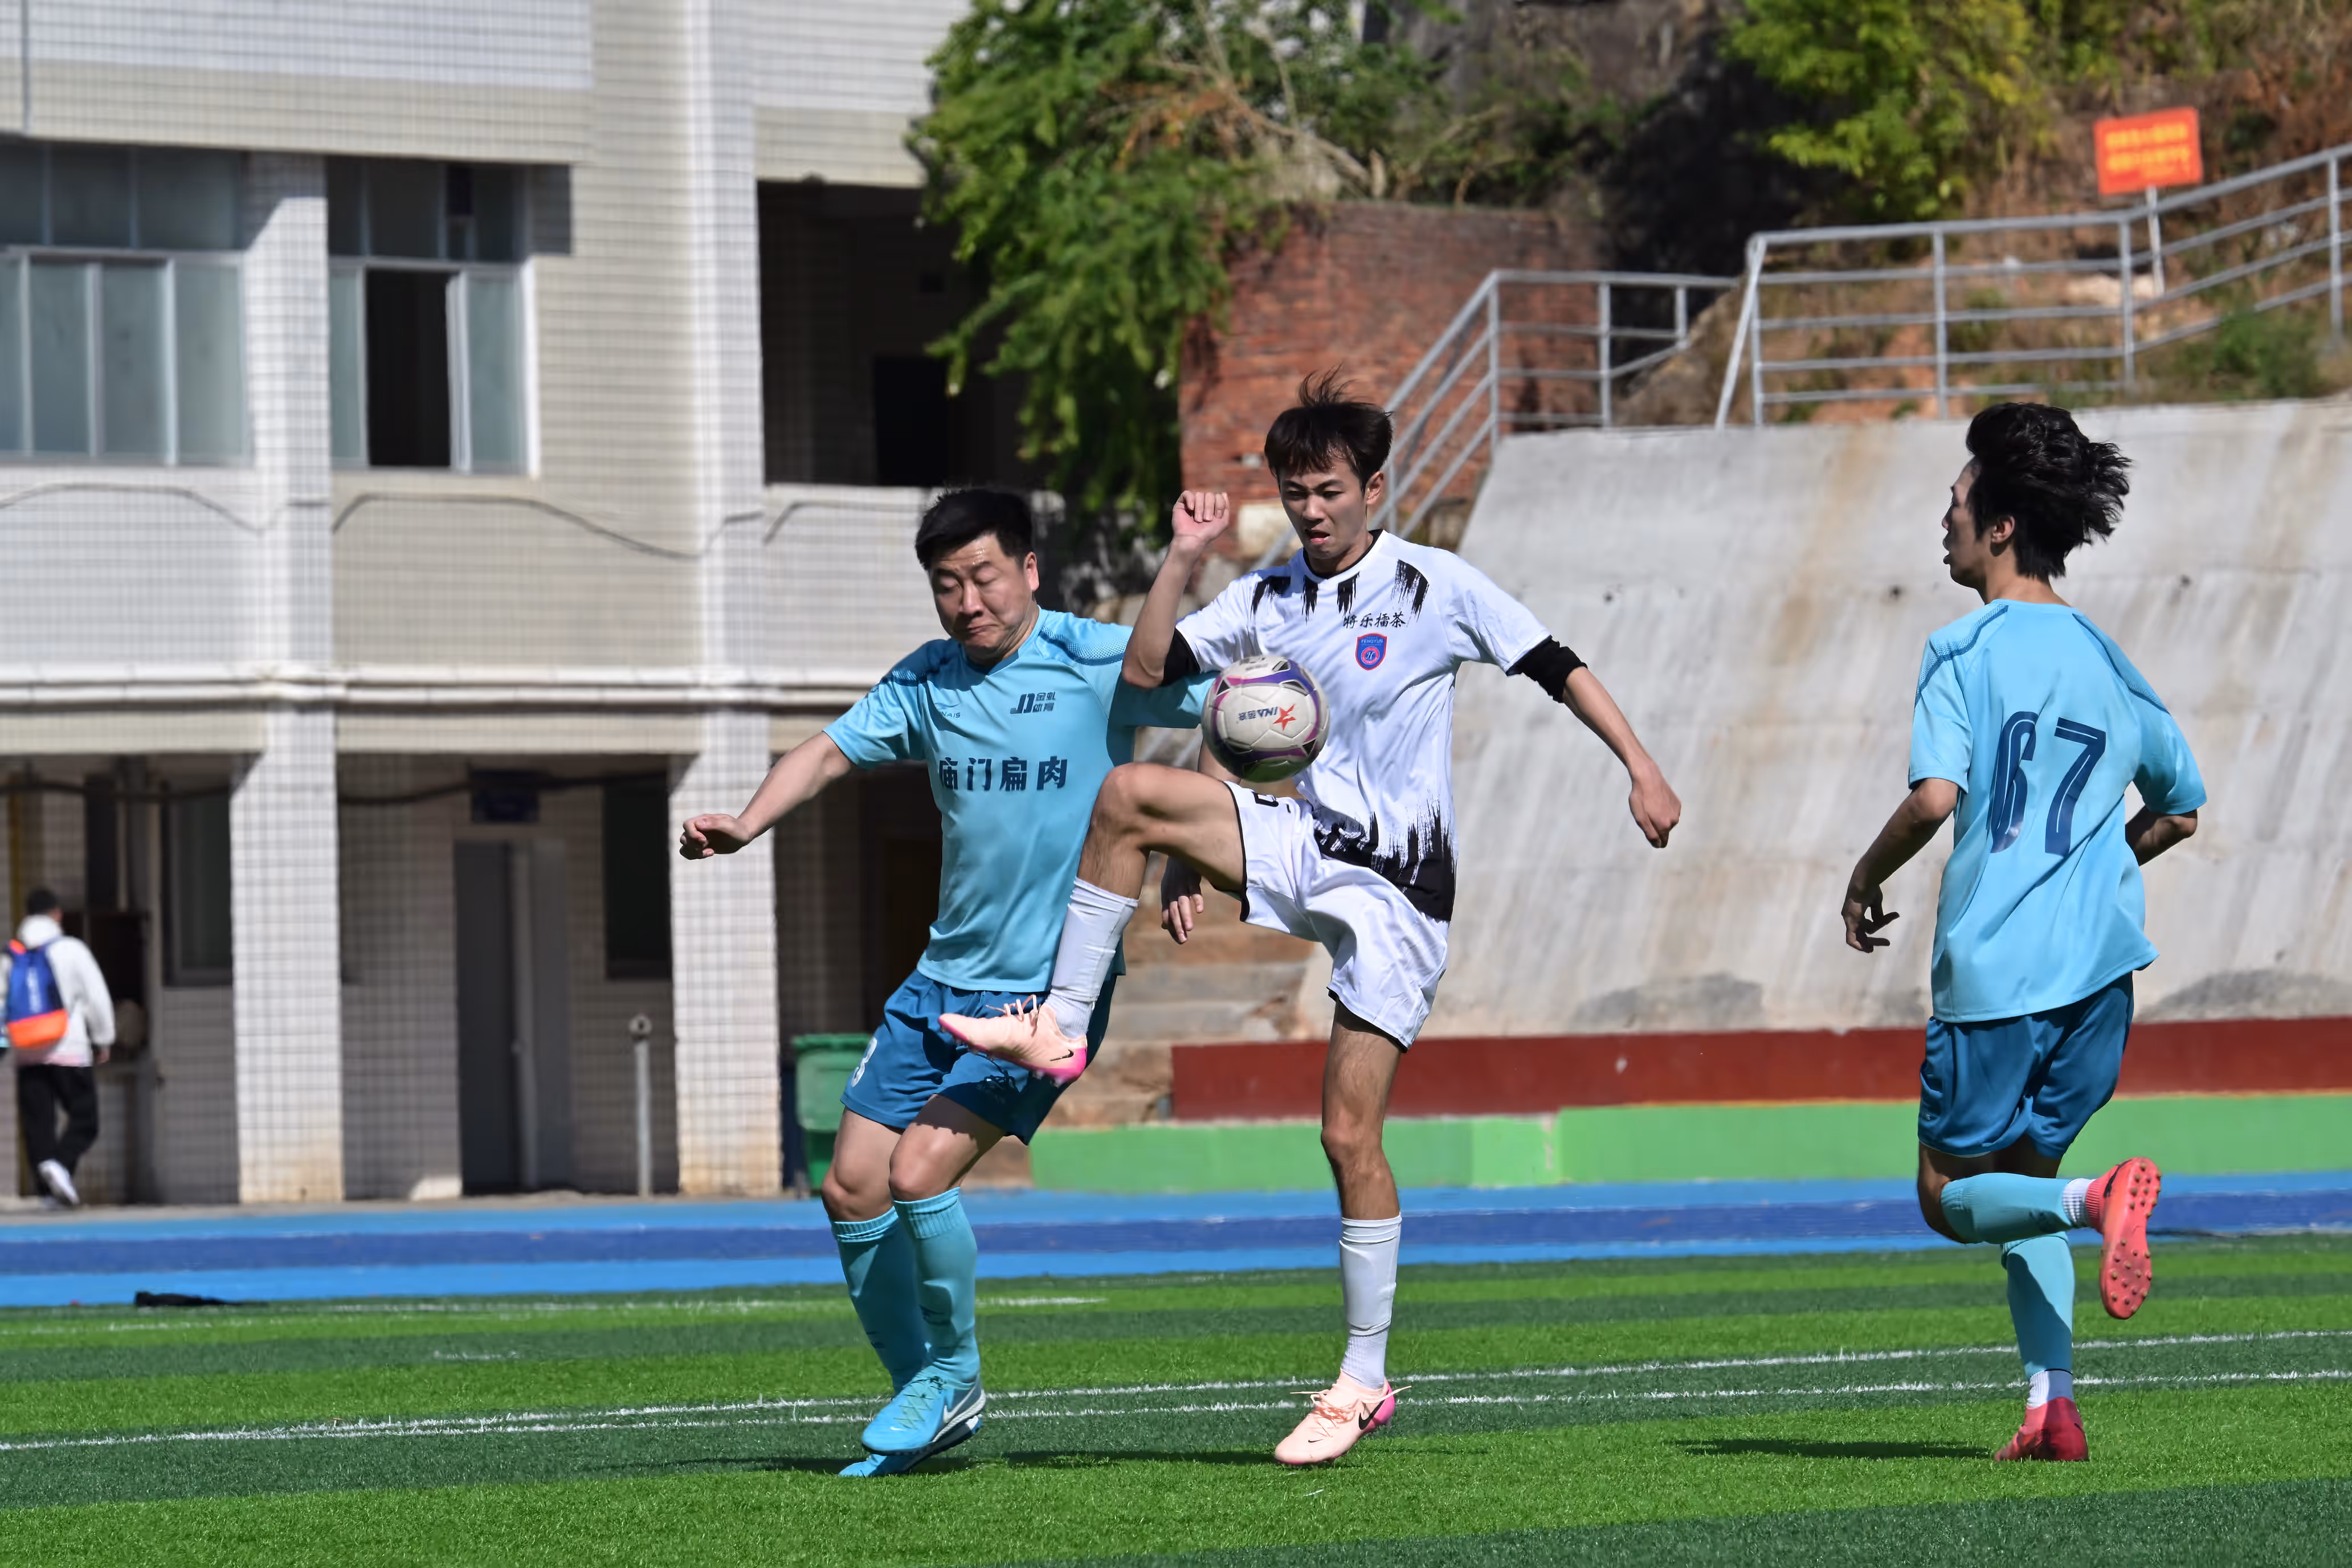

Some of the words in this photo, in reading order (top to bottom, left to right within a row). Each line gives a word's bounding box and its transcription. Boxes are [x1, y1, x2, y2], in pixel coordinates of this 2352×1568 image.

[1343, 611, 1406, 628] 将乐擂茶
[939, 756, 1067, 791] 庙门扁肉
[1990, 711, 2106, 856] 67
